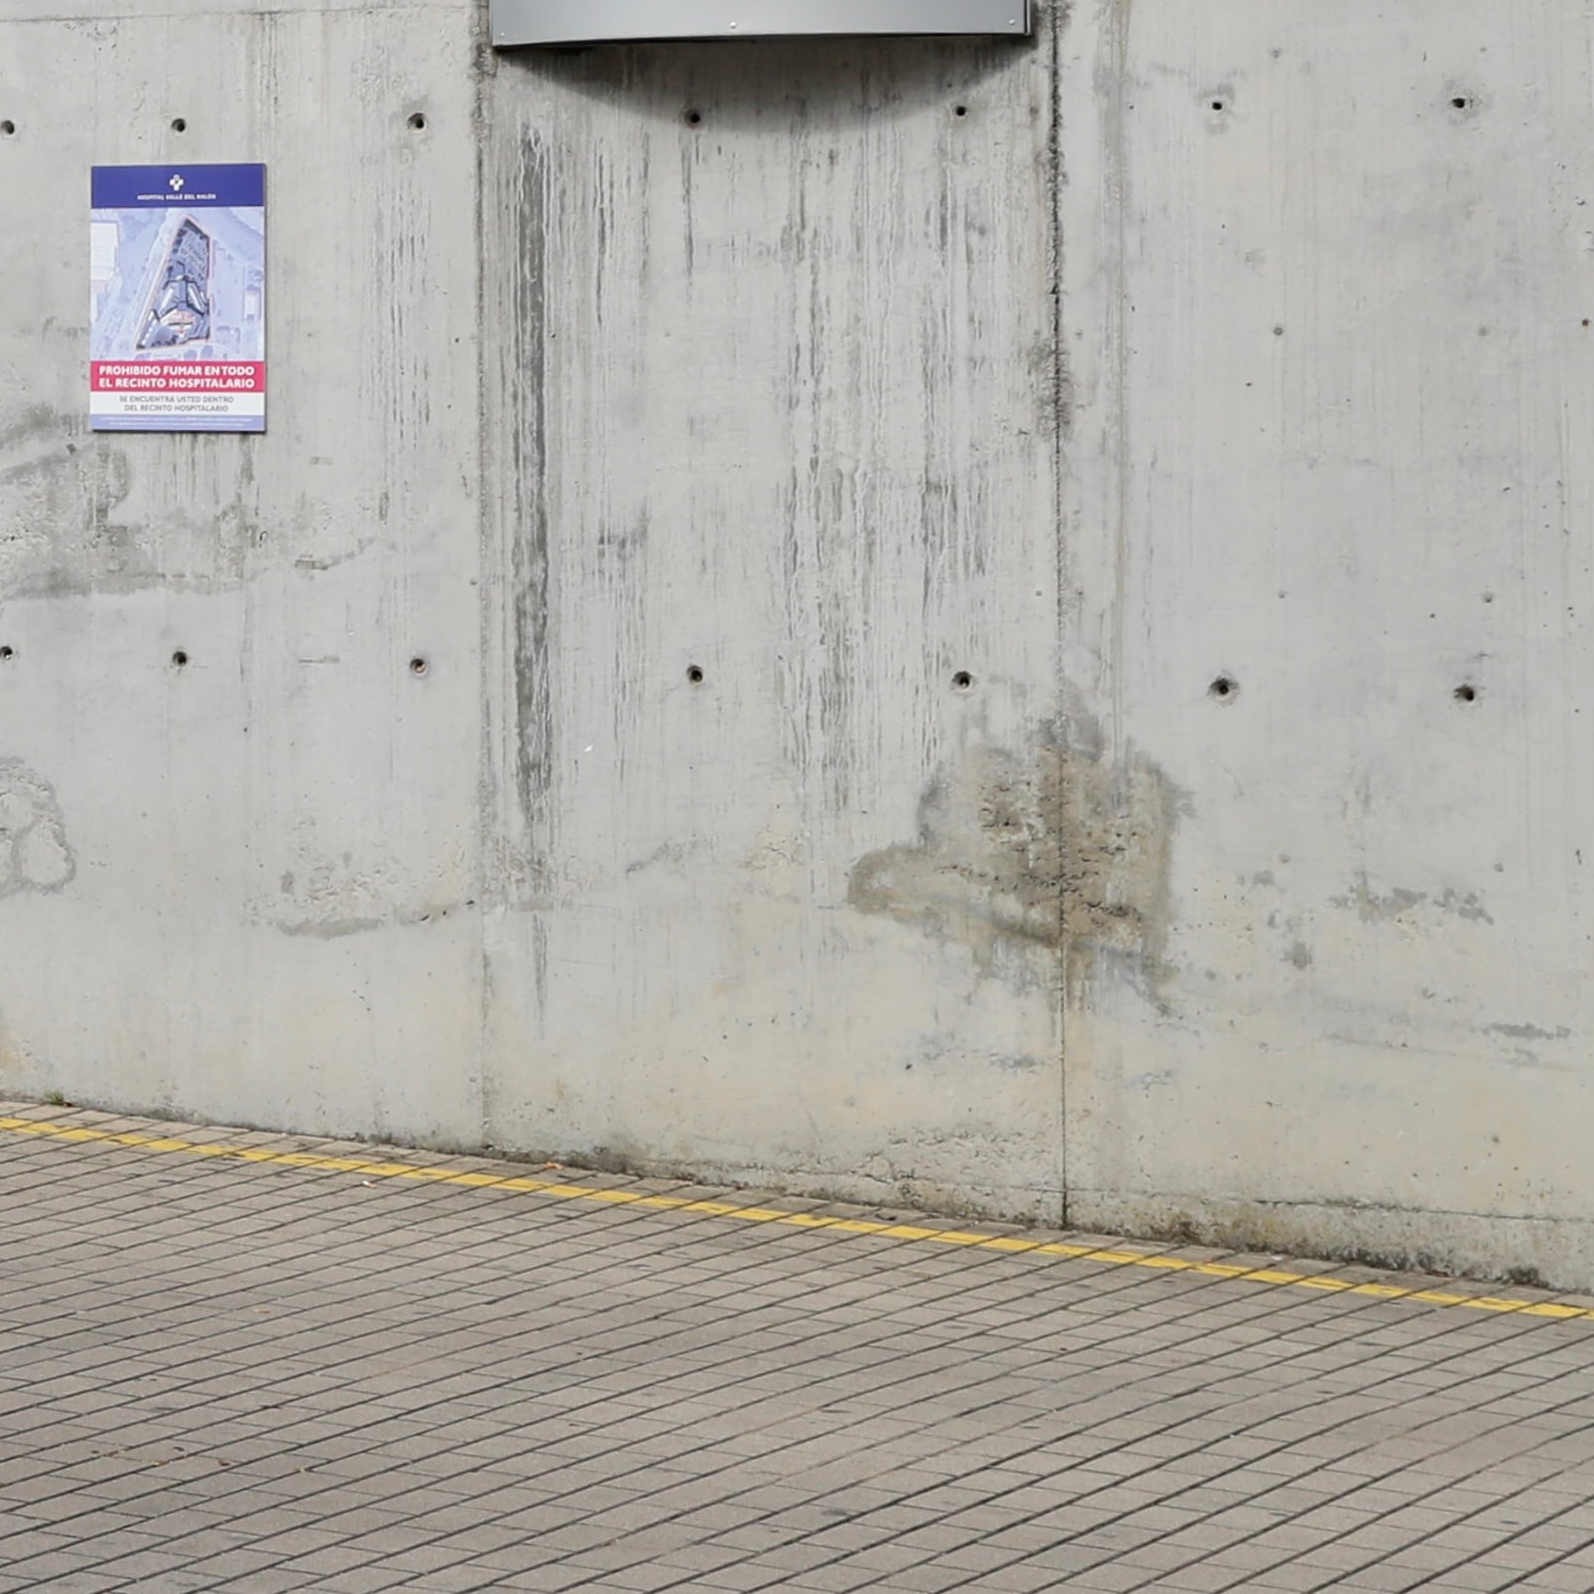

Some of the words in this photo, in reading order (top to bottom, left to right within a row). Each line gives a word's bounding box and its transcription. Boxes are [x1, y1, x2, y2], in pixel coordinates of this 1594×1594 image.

[99, 365, 161, 376] PROHIBIDO
[164, 365, 202, 376] FUMAR
[205, 366, 221, 376] EN
[221, 366, 255, 376] TODO
[99, 378, 112, 388] EL
[115, 378, 166, 388] RECINTO
[169, 378, 255, 388] HOSPITALARIO
[119, 395, 128, 403] SE
[130, 395, 175, 403] ENCUENTRA
[177, 395, 201, 403] USTED
[203, 396, 234, 404] DENTRO
[124, 404, 138, 412] DEL
[140, 404, 172, 412] RECINTO
[174, 404, 229, 412] HOSPITALARIO
